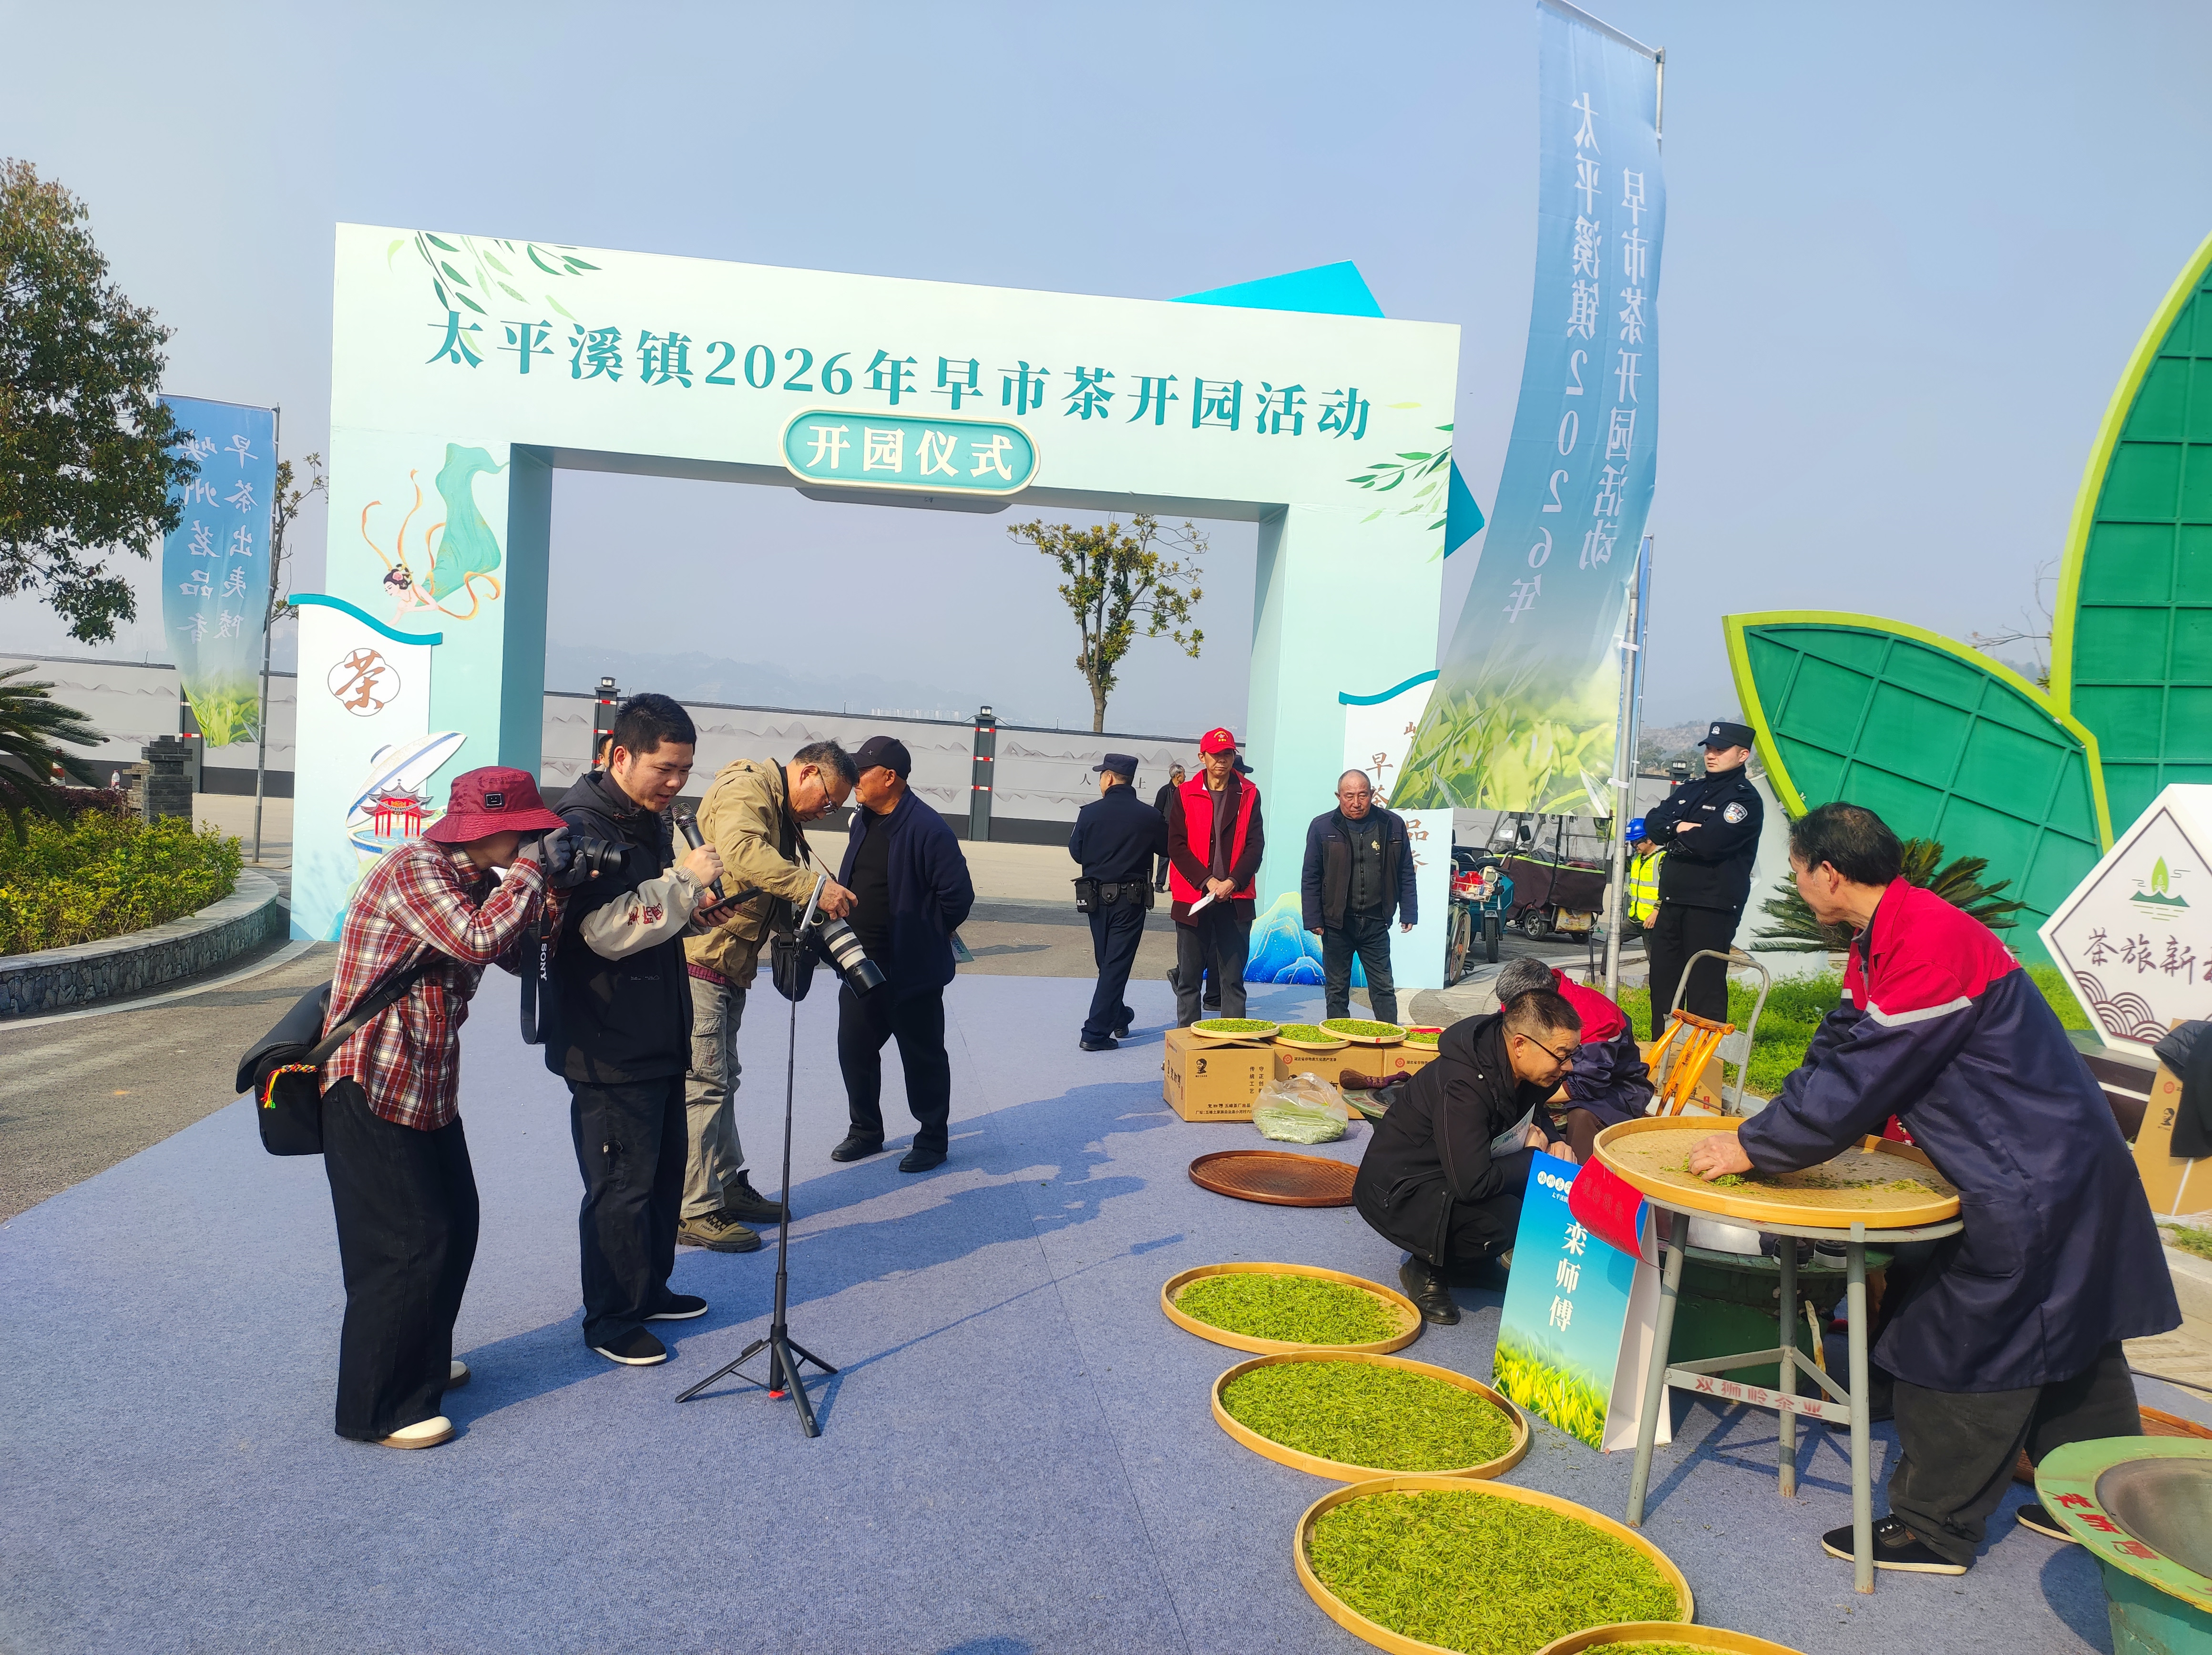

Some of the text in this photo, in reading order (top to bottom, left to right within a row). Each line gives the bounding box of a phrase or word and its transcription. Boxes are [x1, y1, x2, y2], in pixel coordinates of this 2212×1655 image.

[425, 310, 1371, 441] 太平溪镇2026年早市茶开园活动
[806, 424, 1013, 480] 开园仪式
[335, 650, 386, 711] 茶
[1549, 1222, 1588, 1332] 栾师傅
